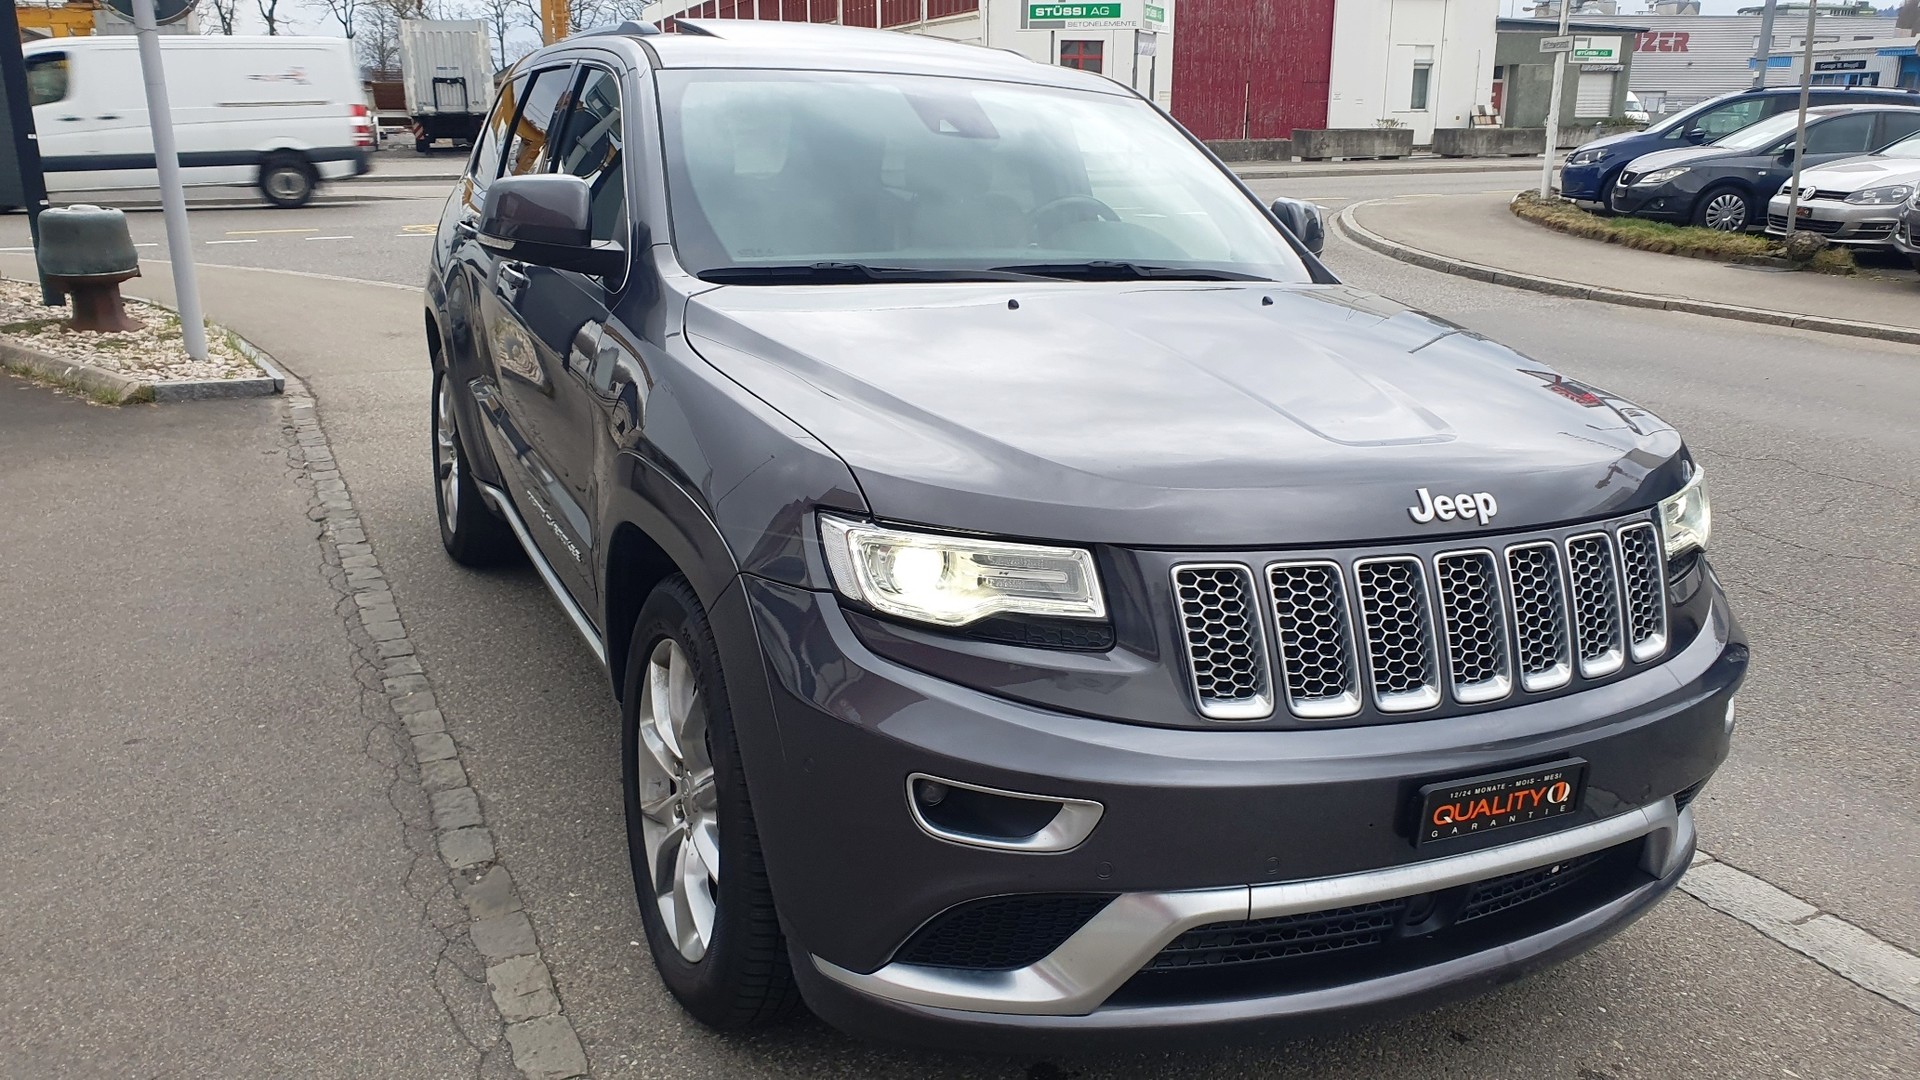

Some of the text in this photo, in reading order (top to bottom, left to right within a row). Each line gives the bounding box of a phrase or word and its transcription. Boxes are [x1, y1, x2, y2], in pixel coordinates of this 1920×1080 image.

[1035, 5, 1110, 16] STÜSSI AG
[1067, 20, 1137, 28] BETONELEMENTE
[1408, 487, 1498, 526] Jeep
[1449, 773, 1563, 799] 12/24 MONATE MOIS MESI
[1431, 804, 1566, 838] GARANTIE
[1433, 787, 1548, 825] QUALITY
